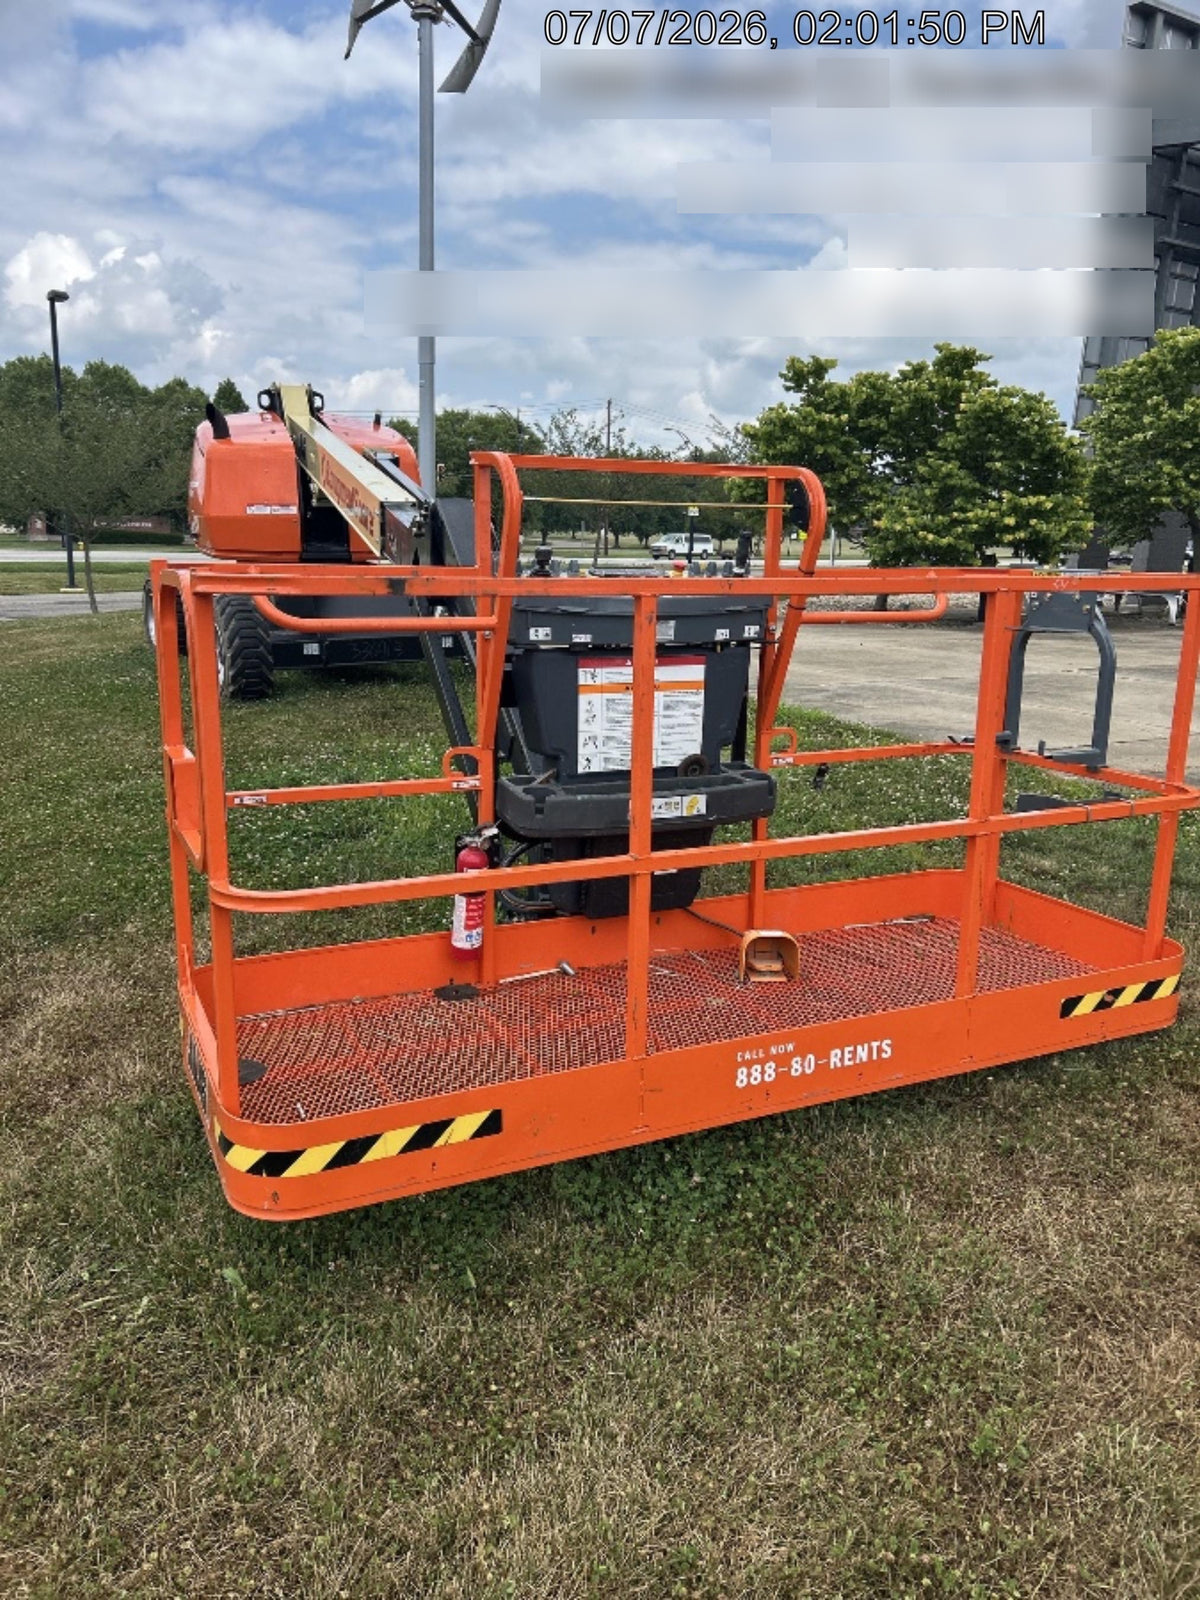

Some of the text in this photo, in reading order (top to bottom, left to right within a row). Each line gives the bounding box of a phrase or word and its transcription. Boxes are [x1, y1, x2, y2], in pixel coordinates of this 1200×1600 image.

[735, 1039, 892, 1088] 888-80-RENTS
[736, 1041, 795, 1062] CALL NOW
